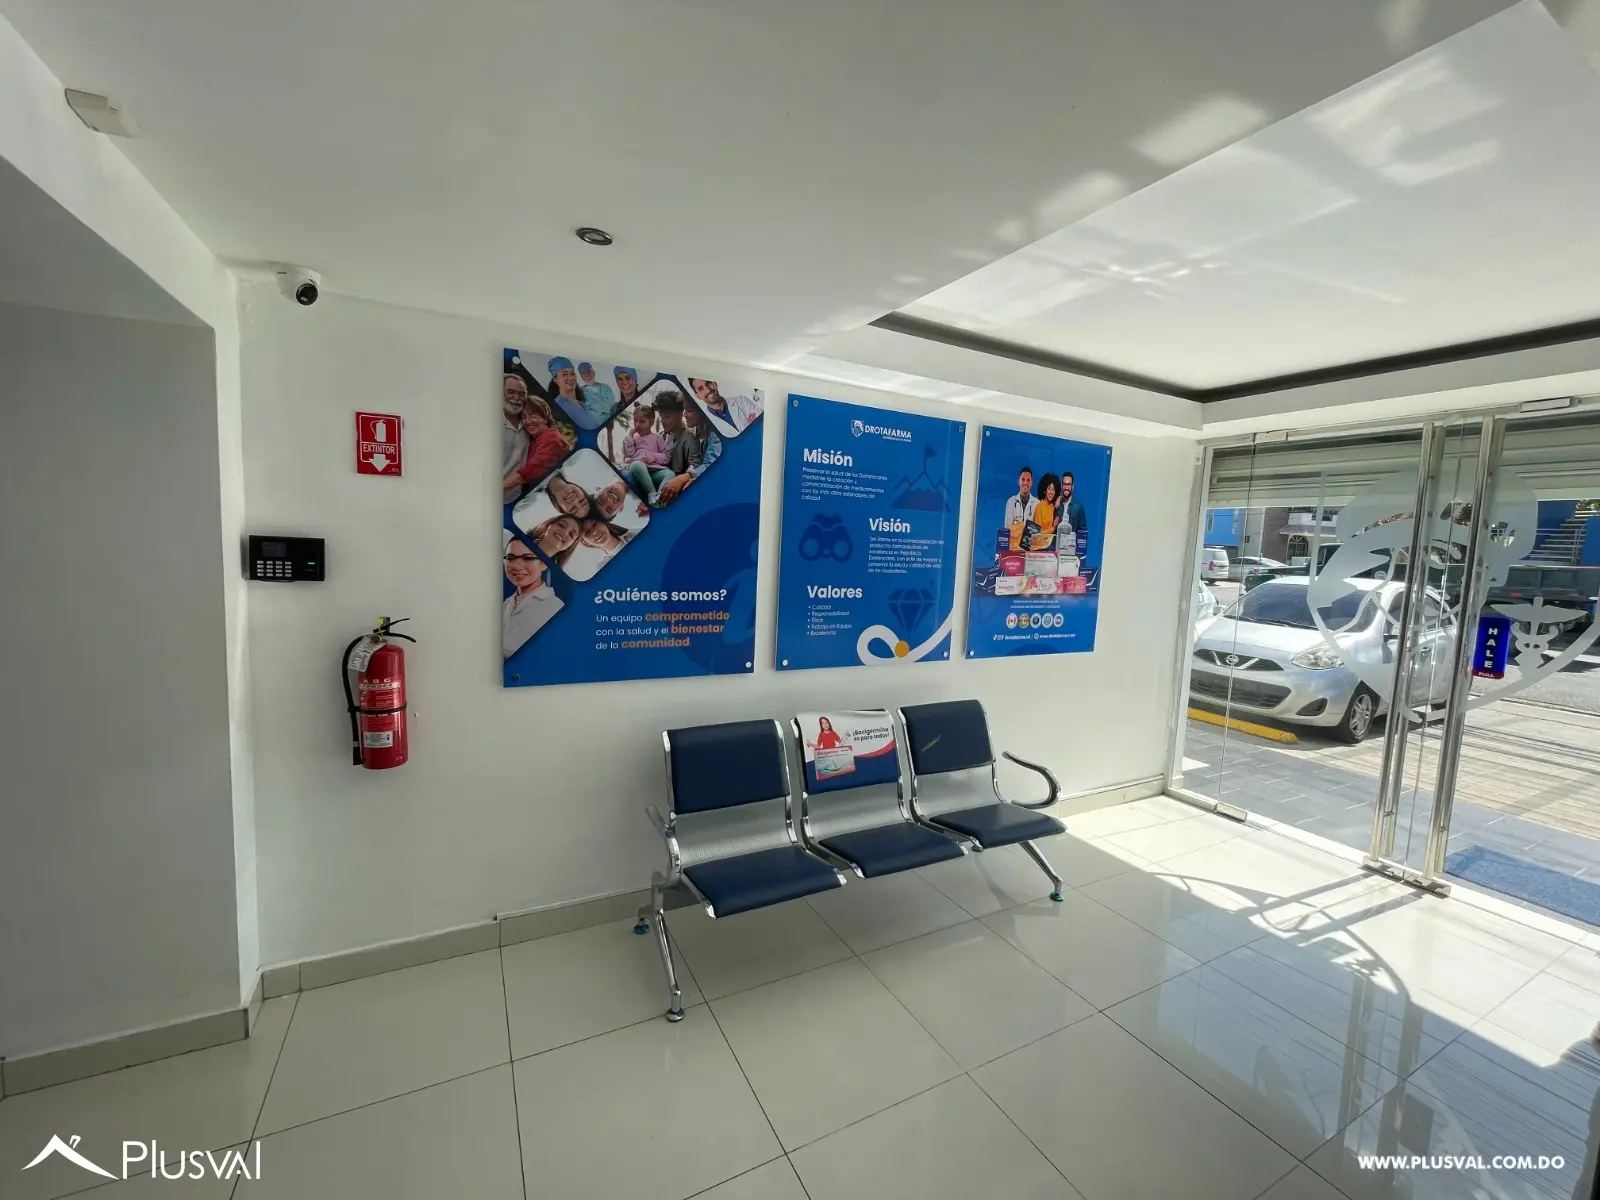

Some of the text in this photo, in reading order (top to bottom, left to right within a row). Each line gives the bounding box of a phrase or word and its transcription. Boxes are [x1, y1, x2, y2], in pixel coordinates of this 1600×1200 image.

[865, 425, 911, 438] DROTAFARMA
[363, 444, 395, 454] EXTINTOR
[803, 448, 853, 467] Misión
[869, 517, 910, 533] Visión
[594, 587, 727, 604] ¿Quiénes somos?
[807, 585, 863, 599] Valores
[596, 610, 729, 624] Un equipo comprometido
[596, 624, 725, 637] con la salud y el bienestar
[595, 637, 690, 650] de la comunidad
[1483, 627, 1498, 668] HALE
